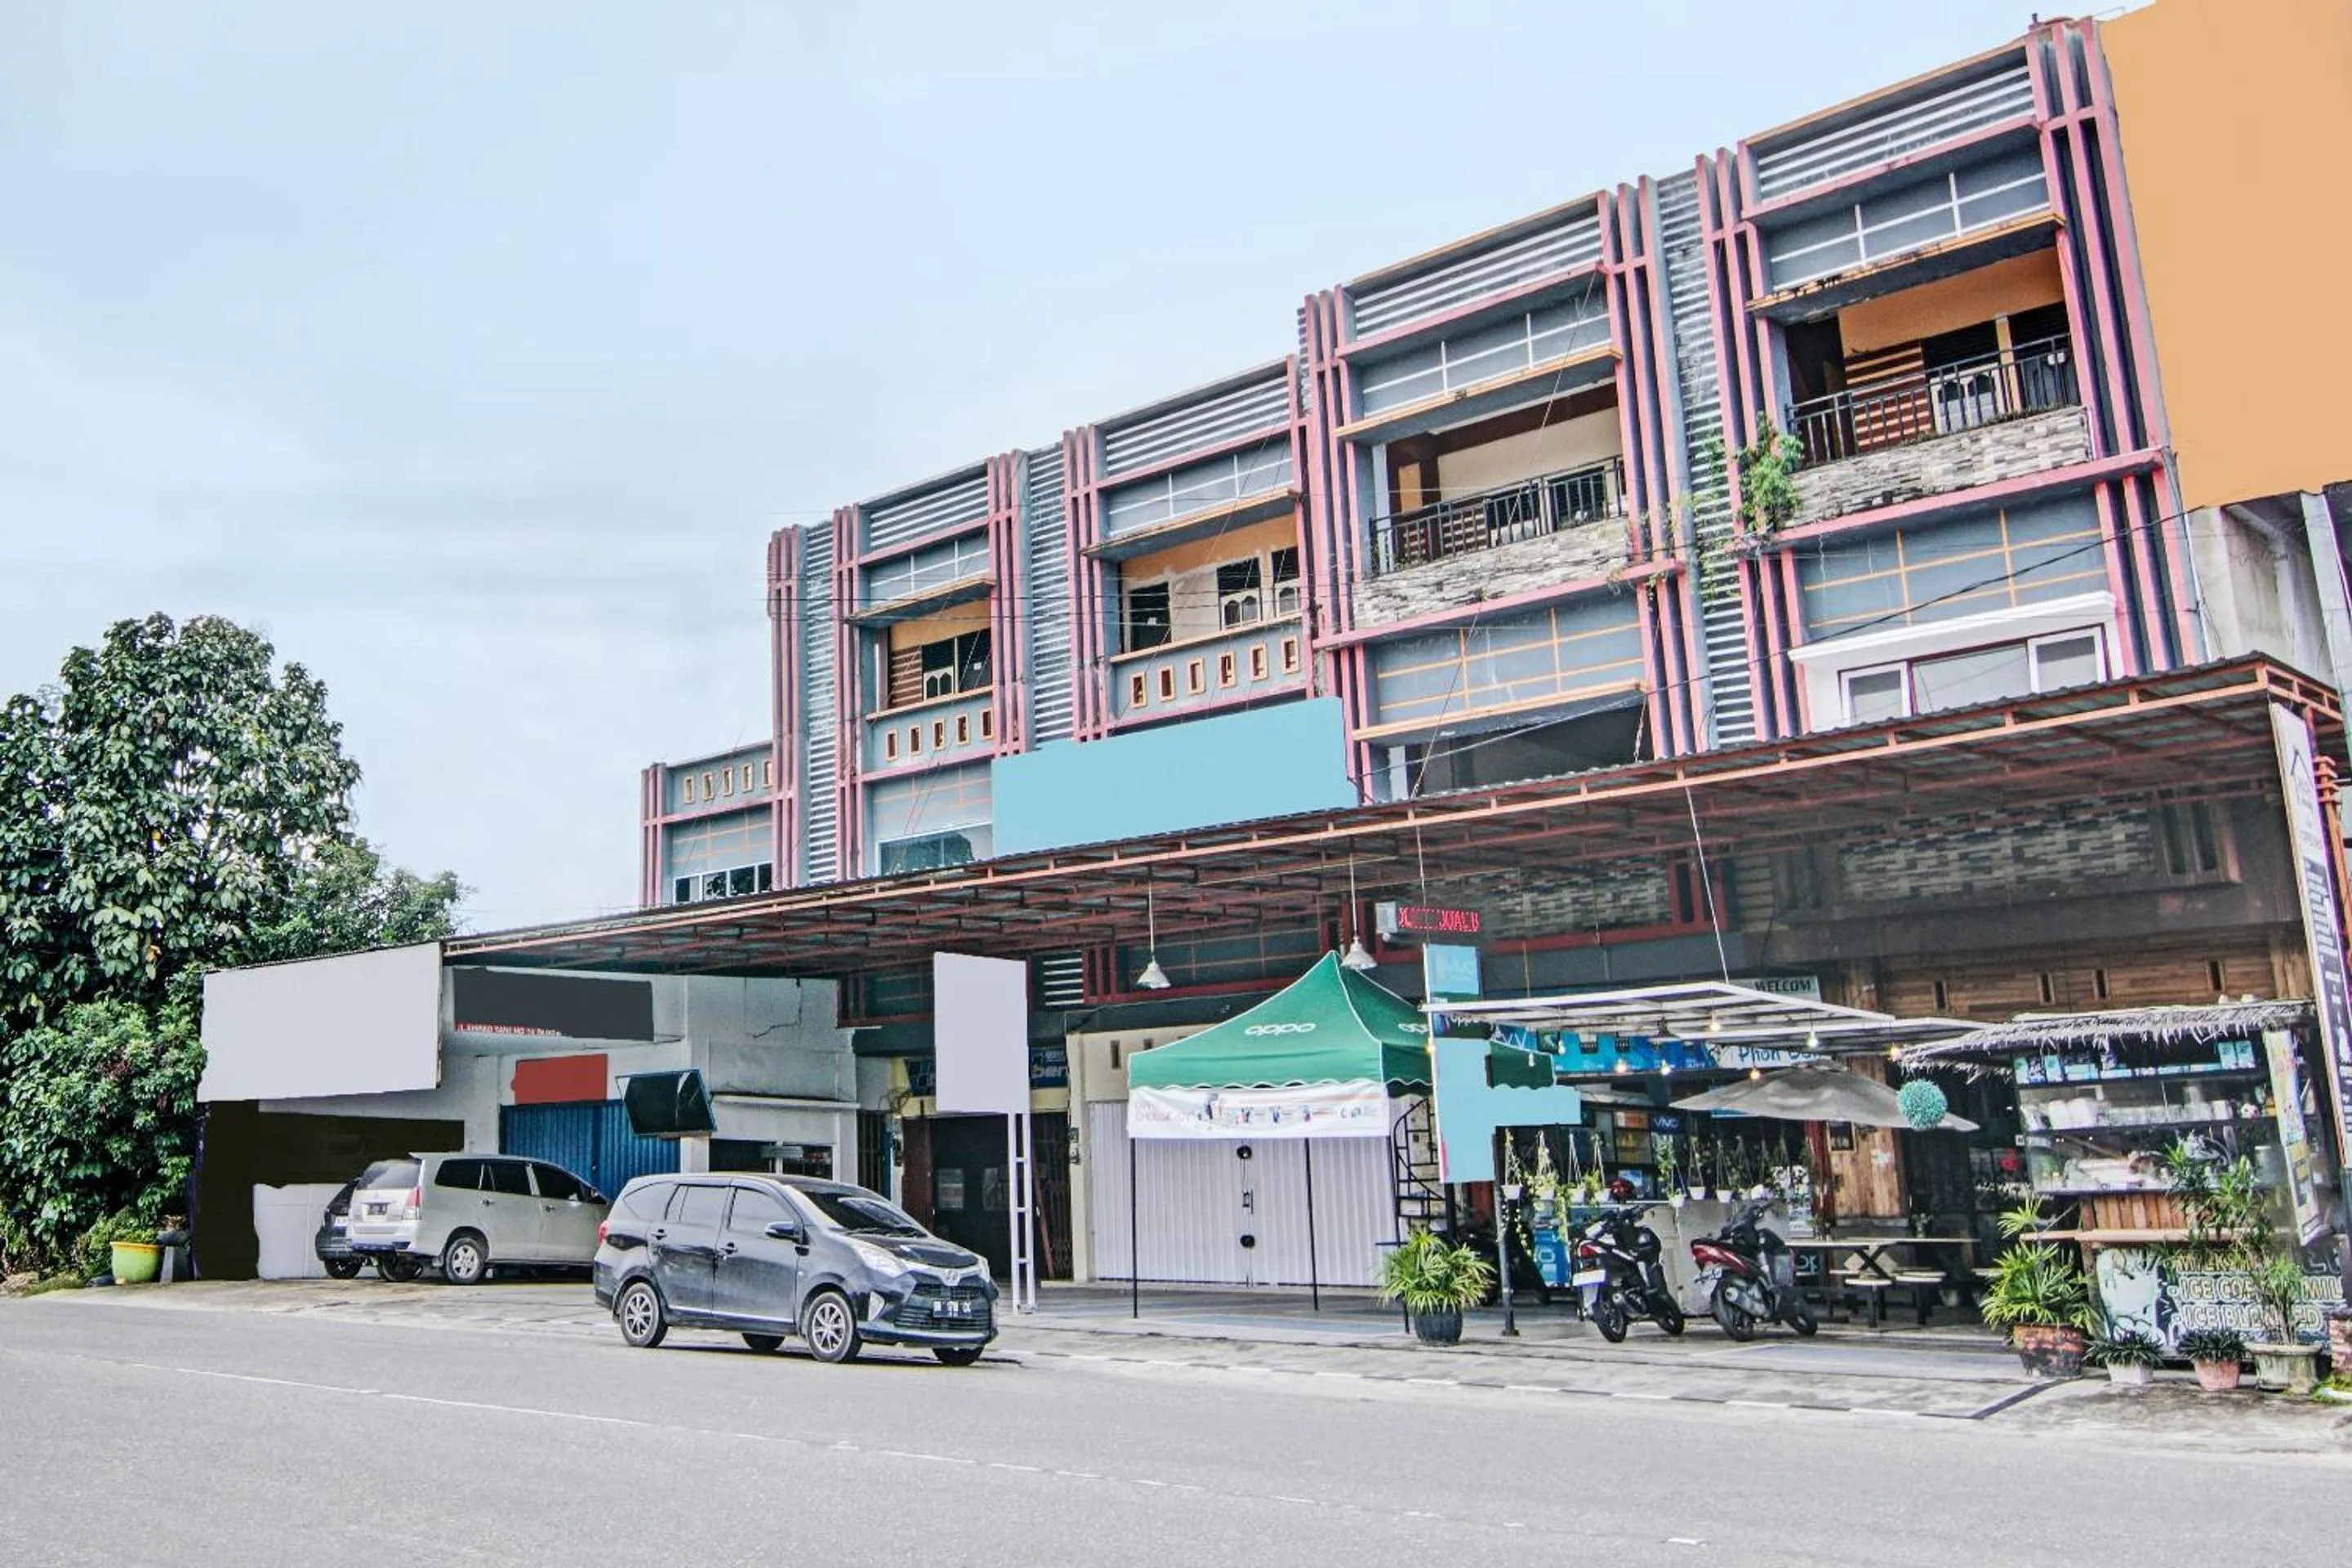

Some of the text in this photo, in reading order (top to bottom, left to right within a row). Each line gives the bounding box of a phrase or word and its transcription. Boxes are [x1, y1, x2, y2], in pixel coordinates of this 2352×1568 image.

[1244, 1022, 1316, 1036] oppo
[2180, 1277, 2214, 1299] ICE
[2185, 1305, 2218, 1330] ICE
